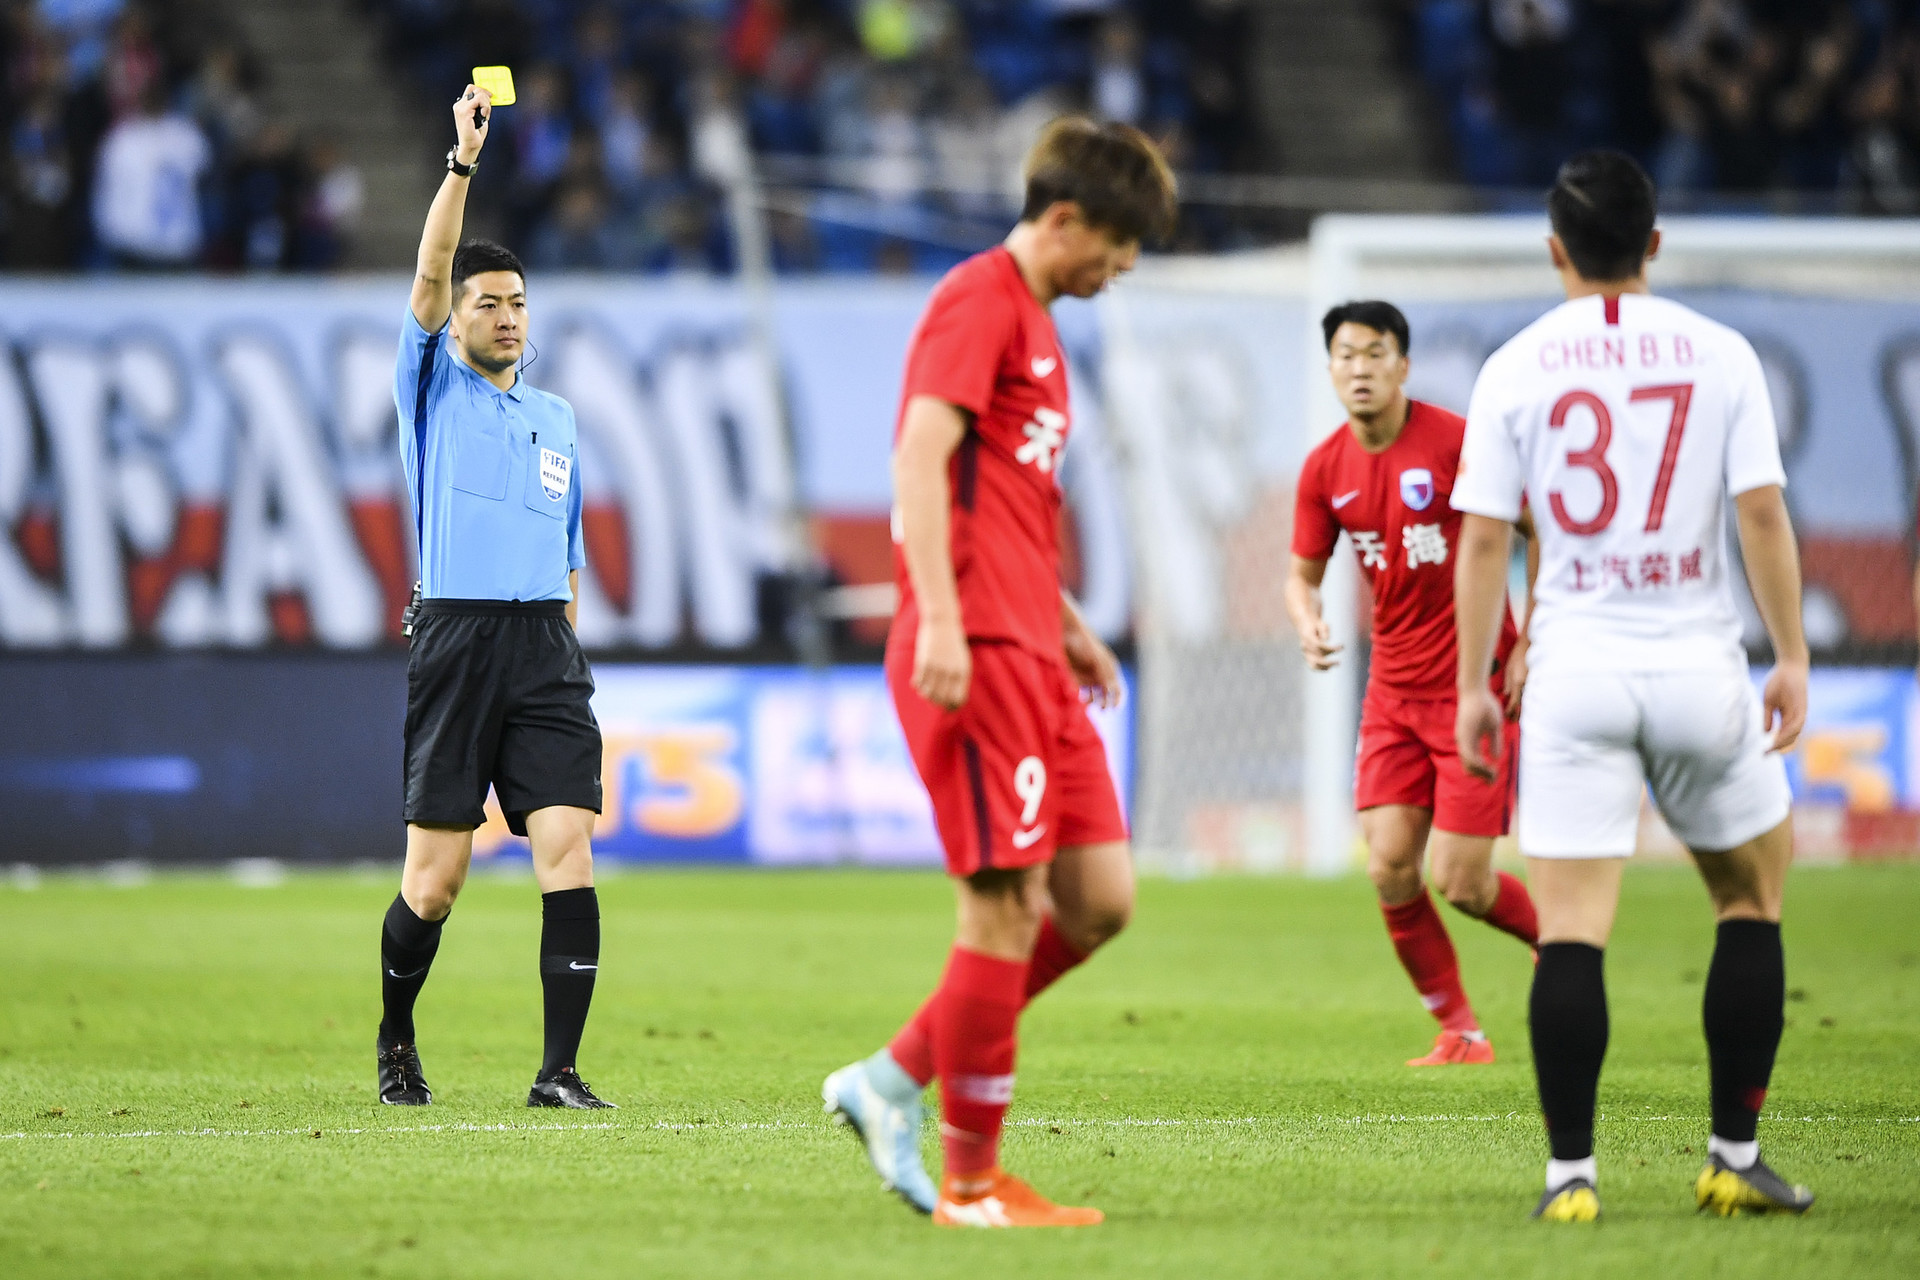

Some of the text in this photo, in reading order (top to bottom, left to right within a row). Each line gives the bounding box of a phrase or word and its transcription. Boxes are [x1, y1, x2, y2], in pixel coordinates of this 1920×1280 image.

[1539, 338, 1625, 373] CHEN
[543, 470, 566, 486] REFEREE
[1548, 382, 1695, 537] 37
[1568, 550, 1703, 592] 上汽荣威
[1014, 756, 1046, 824] 9
